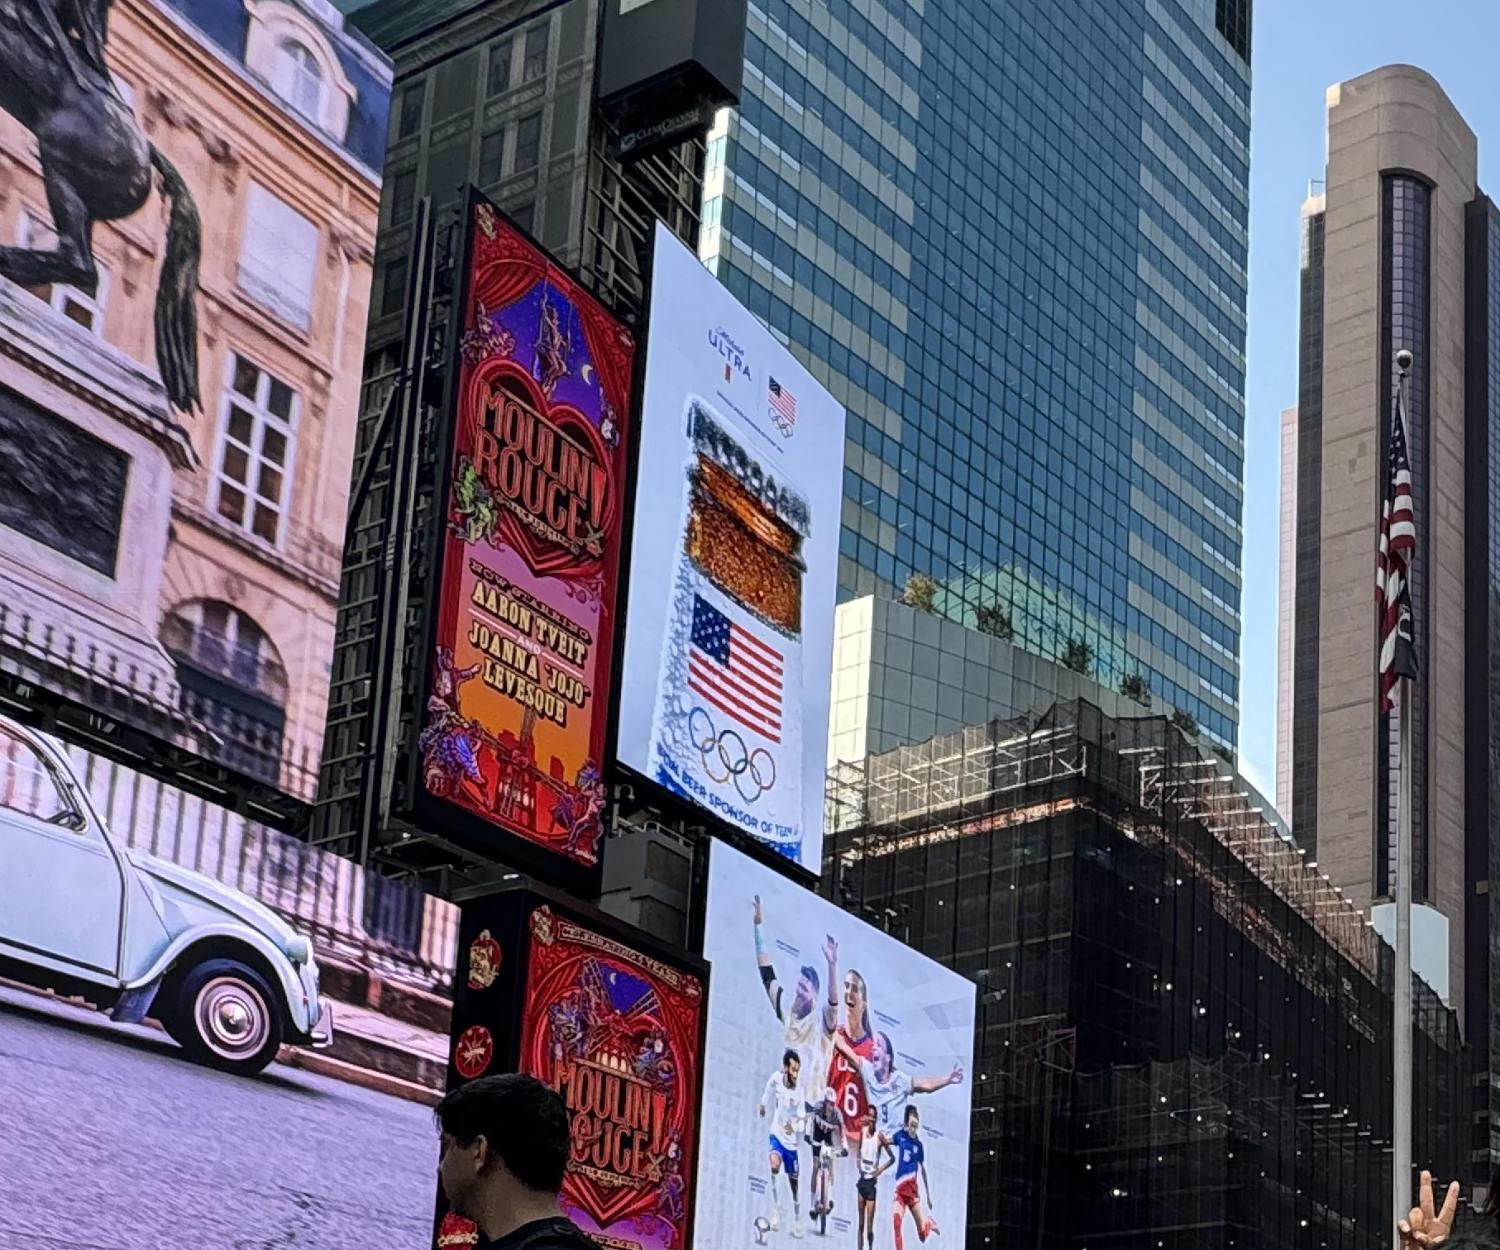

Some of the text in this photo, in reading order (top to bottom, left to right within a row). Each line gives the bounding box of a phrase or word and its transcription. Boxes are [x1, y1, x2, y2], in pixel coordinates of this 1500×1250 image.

[708, 329, 752, 382] ULTRA
[477, 380, 590, 500] MOULIN
[469, 621, 539, 680] JOANNA
[472, 580, 586, 665] AARON TVEIT
[517, 636, 541, 655] AND
[483, 658, 566, 724] LEVESQUE
[682, 770, 706, 797] BEER
[709, 792, 760, 830] SPONSOR
[761, 821, 773, 835] OF
[554, 1060, 652, 1131] MOULIN
[843, 1082, 858, 1117] 6
